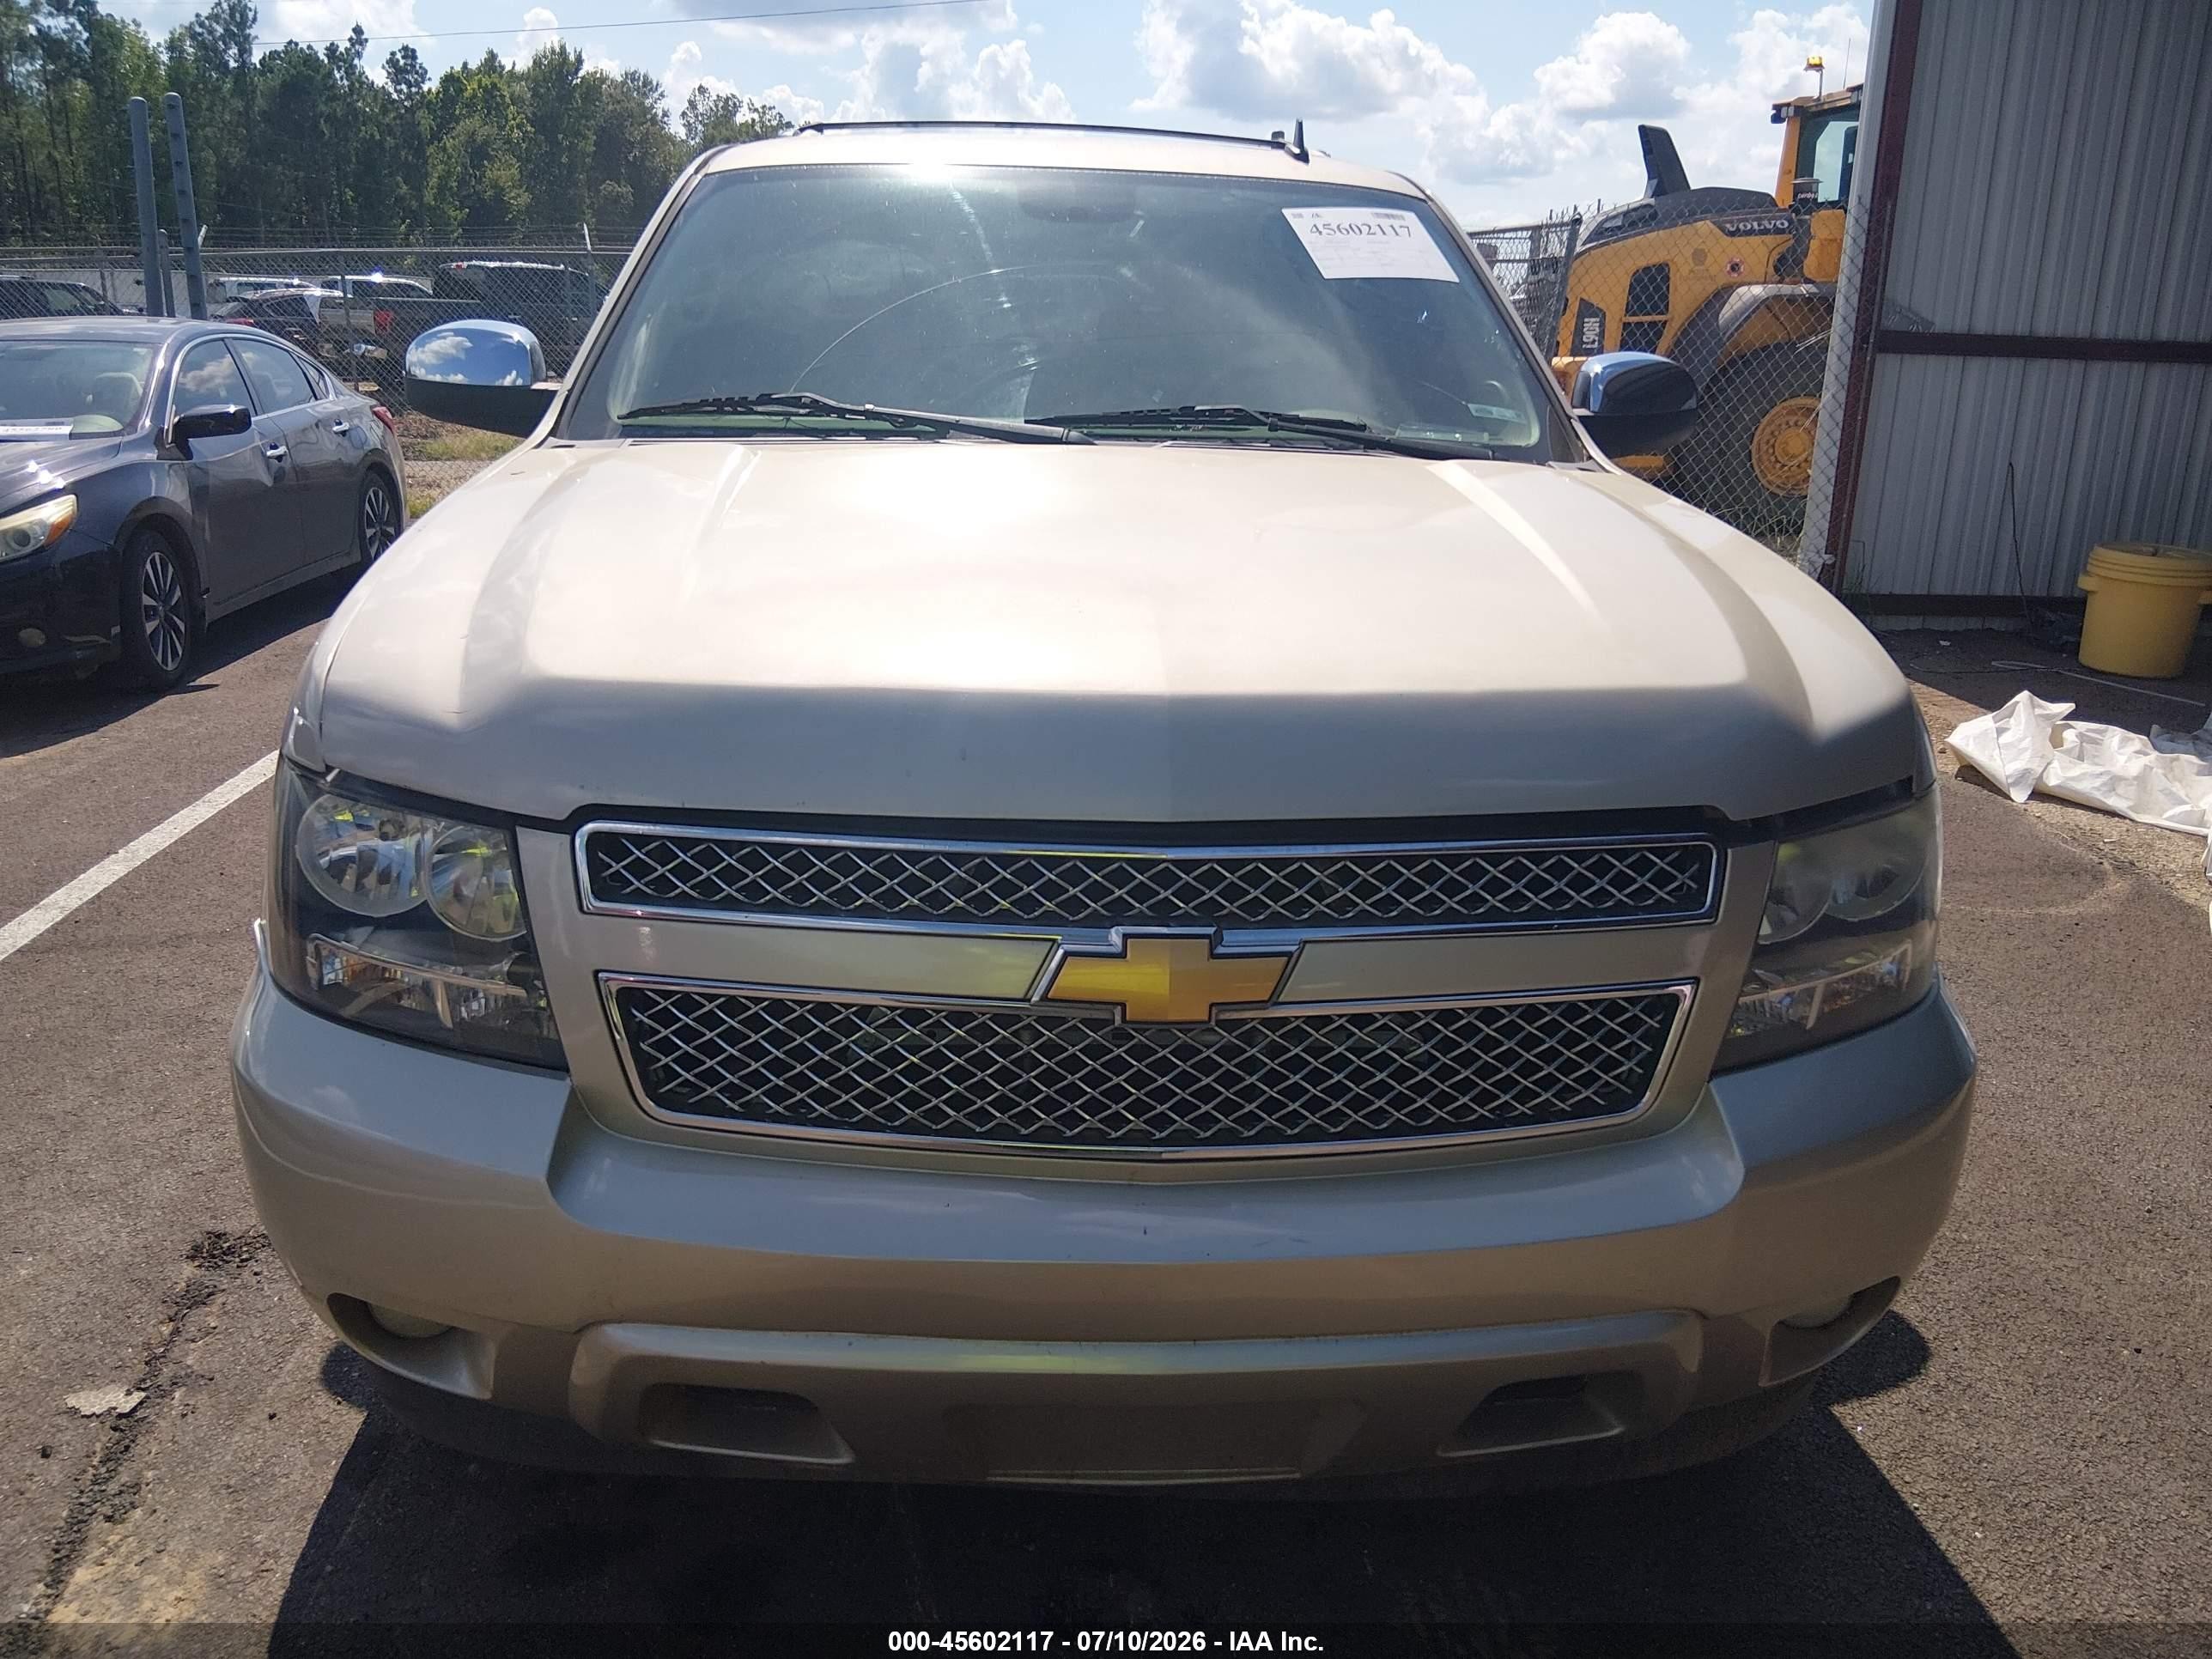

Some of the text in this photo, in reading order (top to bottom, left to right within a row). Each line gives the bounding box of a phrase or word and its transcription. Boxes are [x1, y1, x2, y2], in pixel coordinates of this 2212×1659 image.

[1310, 222, 1412, 237] 45602117
[1725, 219, 1789, 231] VOLVO
[1583, 318, 1600, 349] L90H
